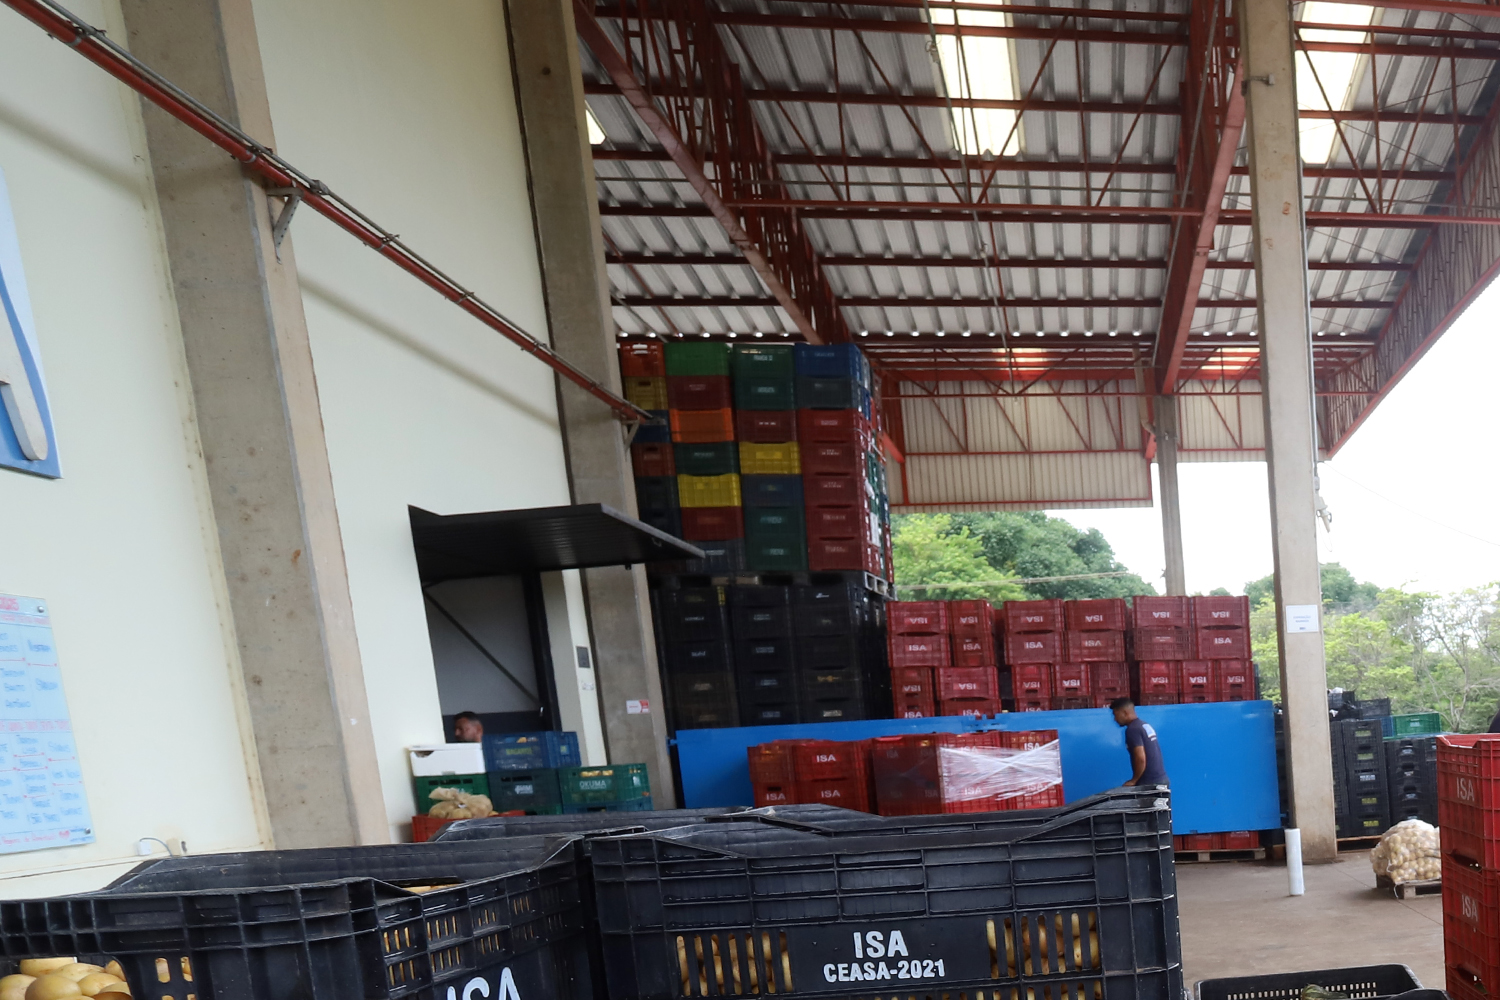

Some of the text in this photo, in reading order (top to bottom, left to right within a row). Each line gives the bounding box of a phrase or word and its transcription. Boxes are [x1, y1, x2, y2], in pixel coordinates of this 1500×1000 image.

[816, 755, 836, 763] ISA
[766, 793, 786, 801] ISA
[821, 790, 841, 798] ISA
[1456, 777, 1474, 802] ISA
[1462, 894, 1478, 922] ISA
[852, 930, 910, 960] ISA
[823, 958, 946, 984] CEASA-2021
